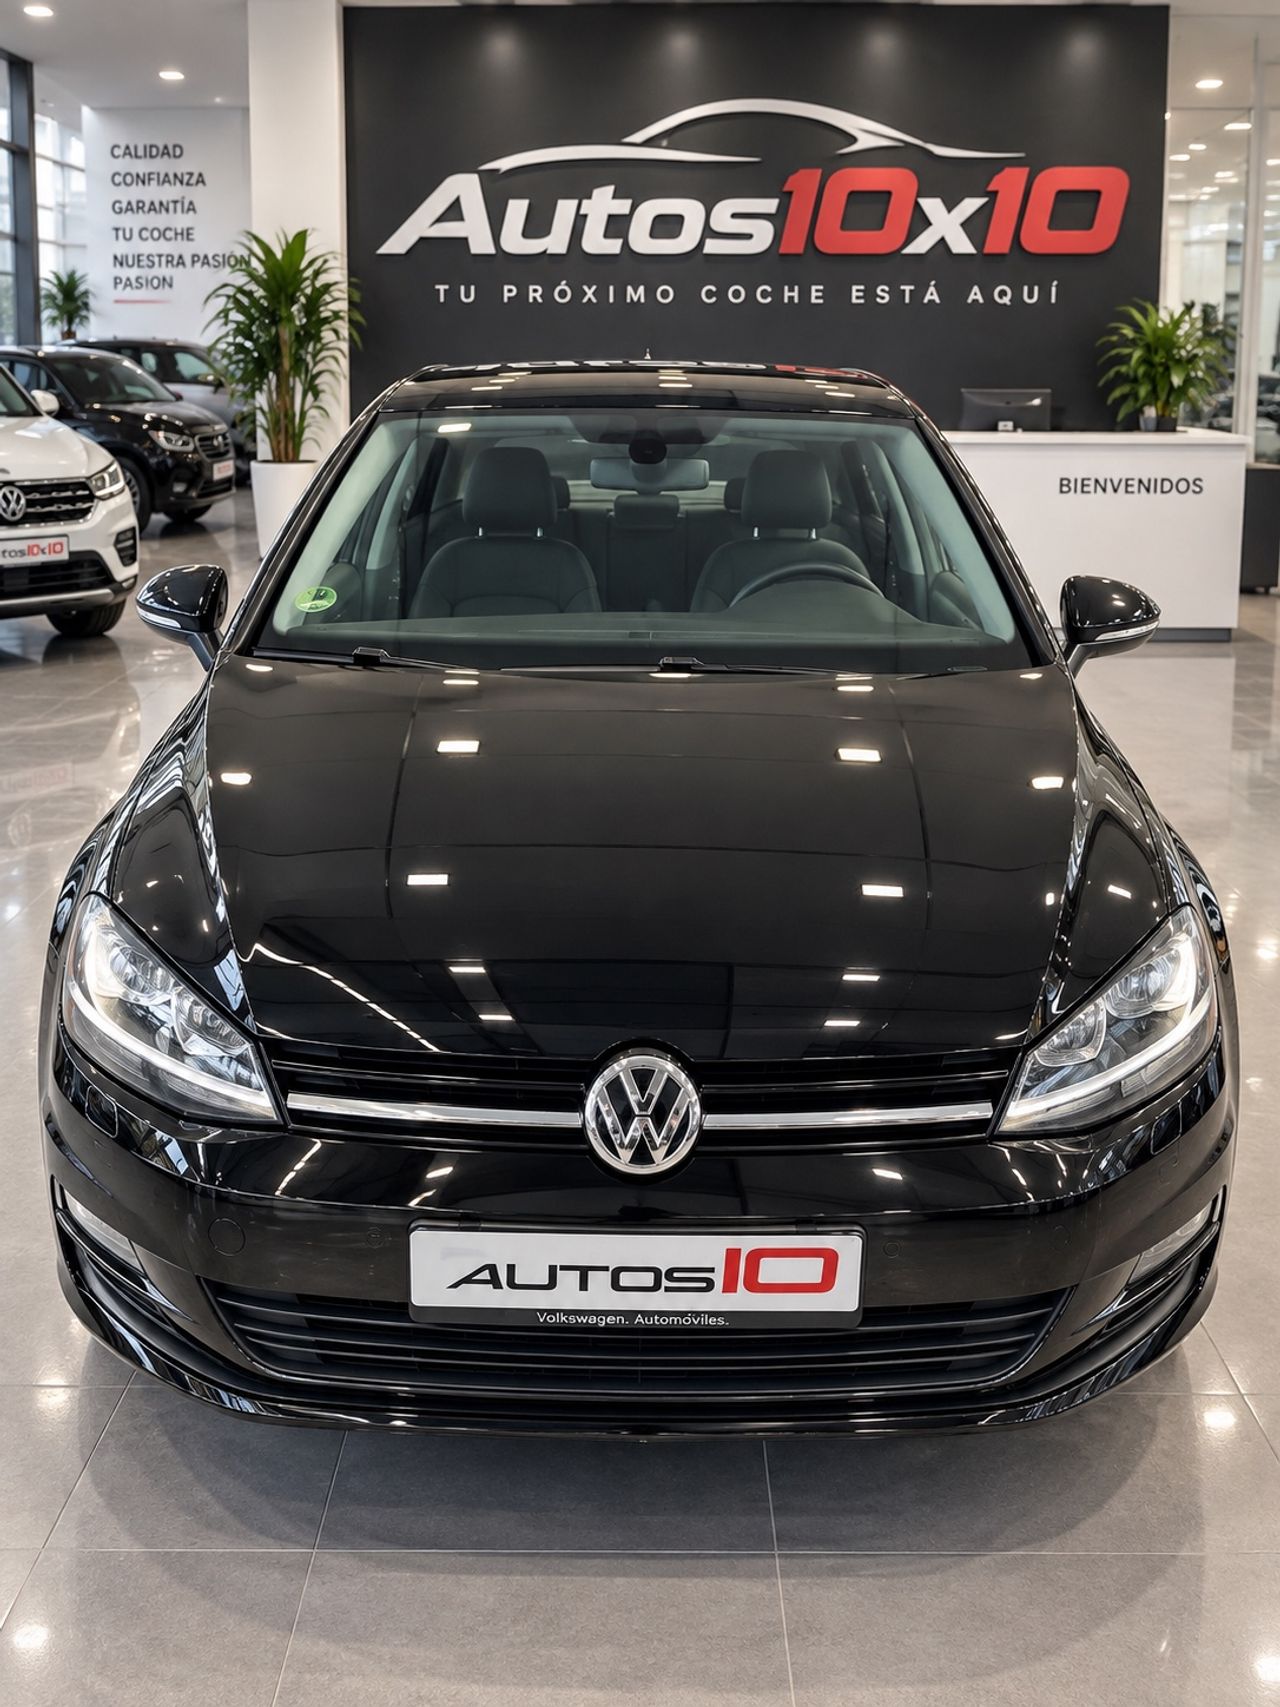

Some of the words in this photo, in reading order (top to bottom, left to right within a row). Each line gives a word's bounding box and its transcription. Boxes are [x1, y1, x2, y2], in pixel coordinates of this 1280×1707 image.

[110, 144, 184, 159] CALIDAD
[111, 172, 207, 187] CONFIANZA
[112, 196, 197, 215] GARANTÍA
[376, 166, 1130, 256] Autos10x10
[113, 227, 133, 242] TU
[138, 227, 195, 242] COCHE
[113, 254, 186, 269] NUESTRA
[191, 251, 251, 269] PASIÓN
[113, 276, 173, 290] PASION
[435, 285, 476, 303] TU
[503, 280, 674, 303] PRÓXIMO
[700, 285, 824, 303] COCHE
[851, 280, 940, 303] ESTÁ
[967, 280, 1058, 306] AQUÍ
[1058, 477, 1204, 495] BIENVENIDOS
[446, 1247, 839, 1294] AUTOS10
[536, 1312, 629, 1327] Volkswagen.
[634, 1313, 730, 1326] Automóviles.
